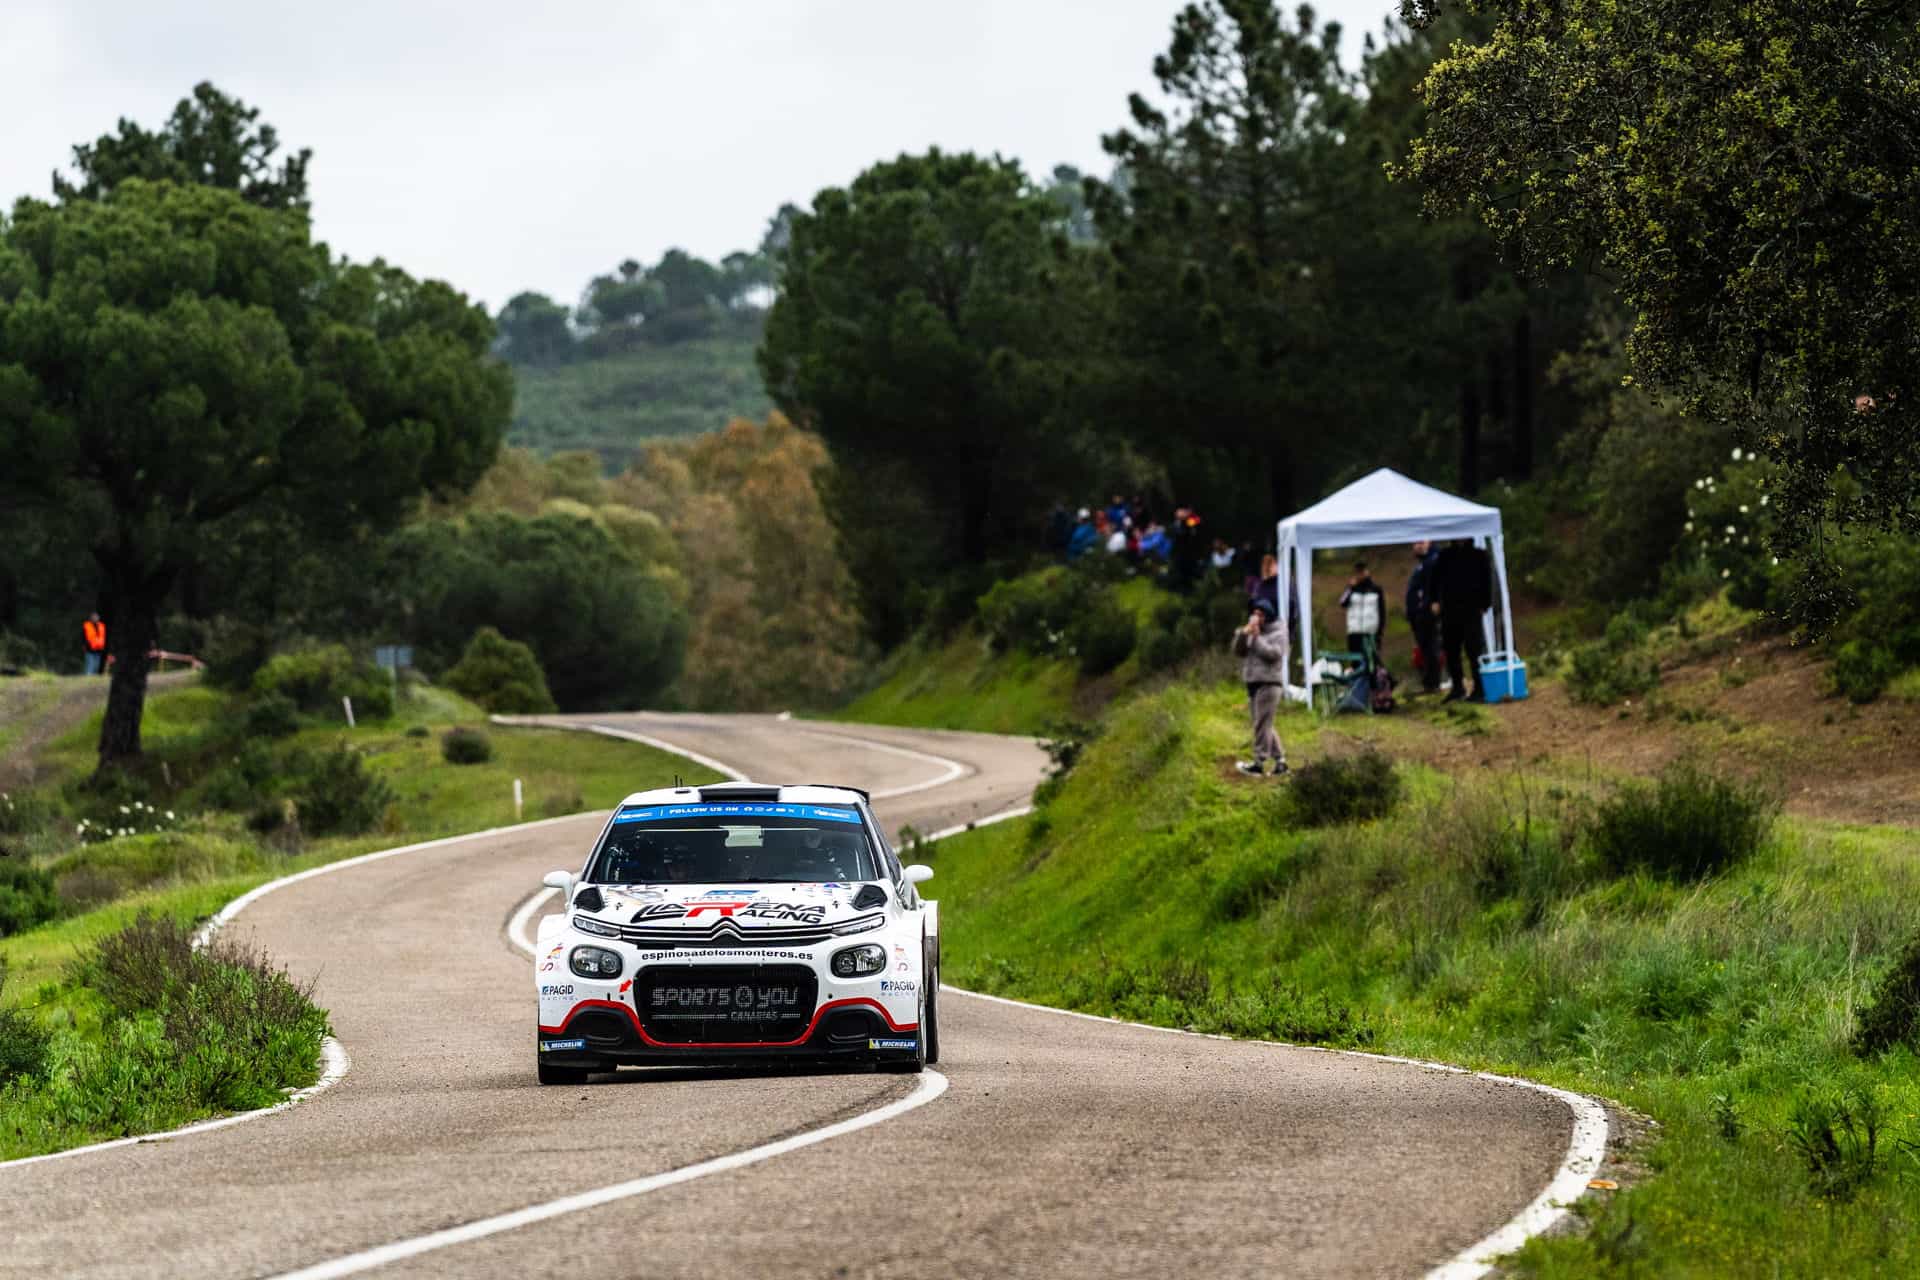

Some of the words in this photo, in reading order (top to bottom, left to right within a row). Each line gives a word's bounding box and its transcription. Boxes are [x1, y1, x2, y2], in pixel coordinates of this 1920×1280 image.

[669, 807, 707, 815] FOLLOW
[641, 949, 814, 961] espinosadelosmonteros.es
[549, 984, 574, 996] PAGID
[889, 980, 916, 991] PAGID
[650, 986, 731, 1006] SPORTS
[551, 1041, 583, 1049] MICHELIN
